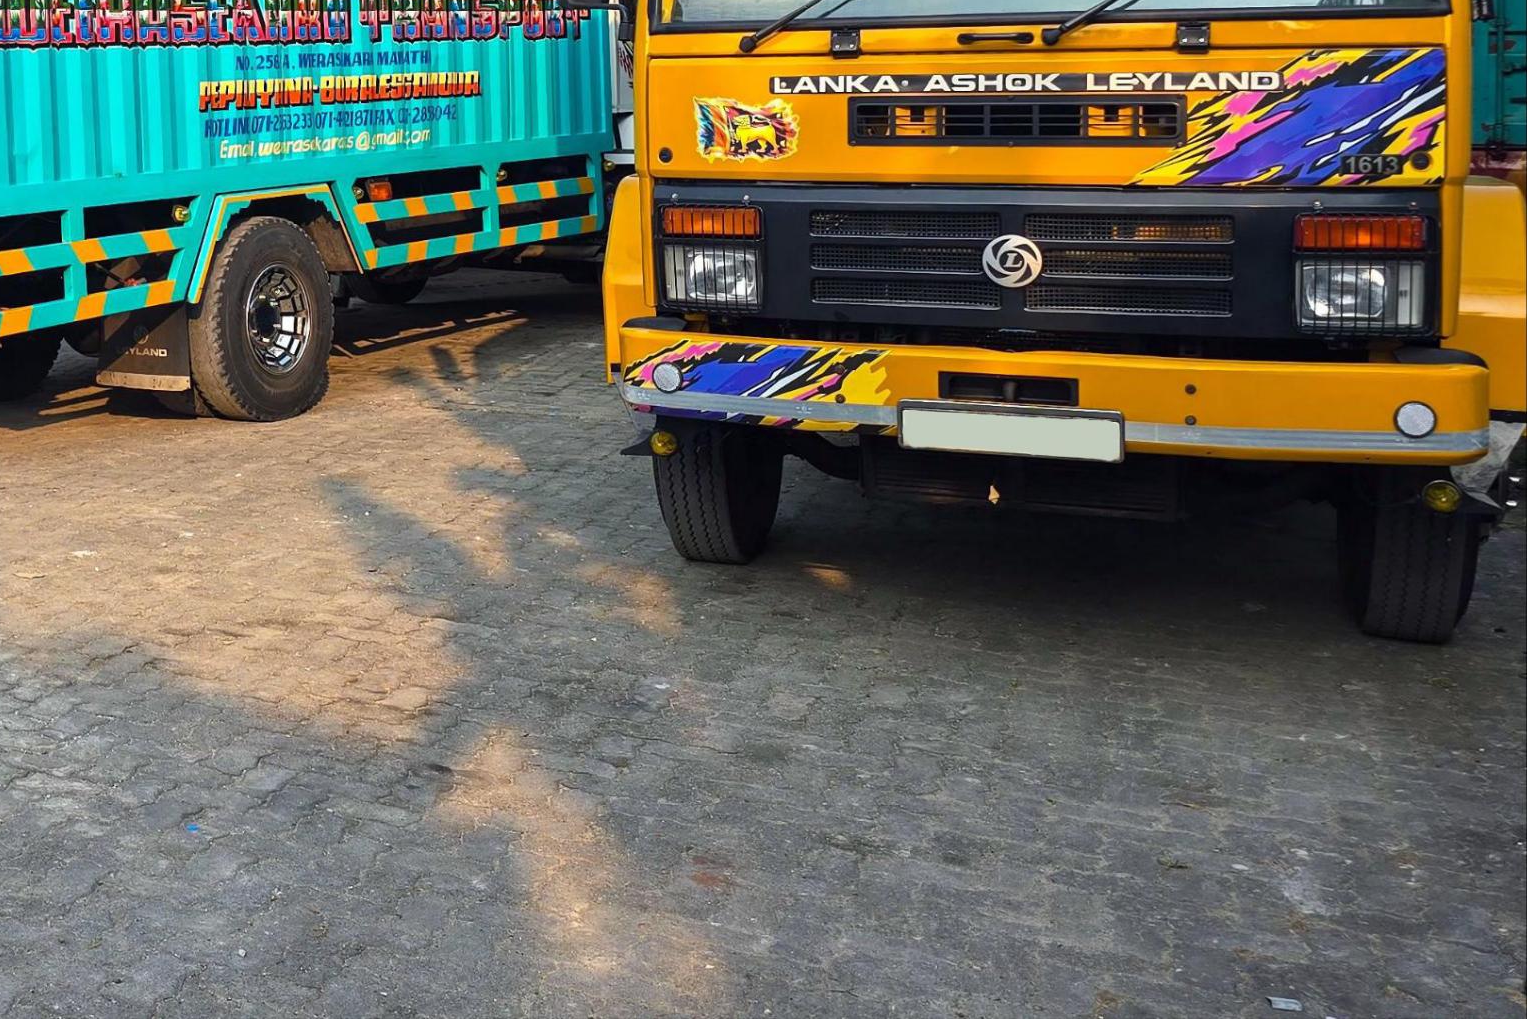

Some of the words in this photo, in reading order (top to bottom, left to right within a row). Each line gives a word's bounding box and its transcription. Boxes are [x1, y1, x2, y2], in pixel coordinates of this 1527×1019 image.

[774, 75, 900, 93] LANKA
[923, 74, 1061, 92] ASHOK
[1086, 72, 1281, 91] LEYLAND
[1345, 156, 1399, 173] 1613
